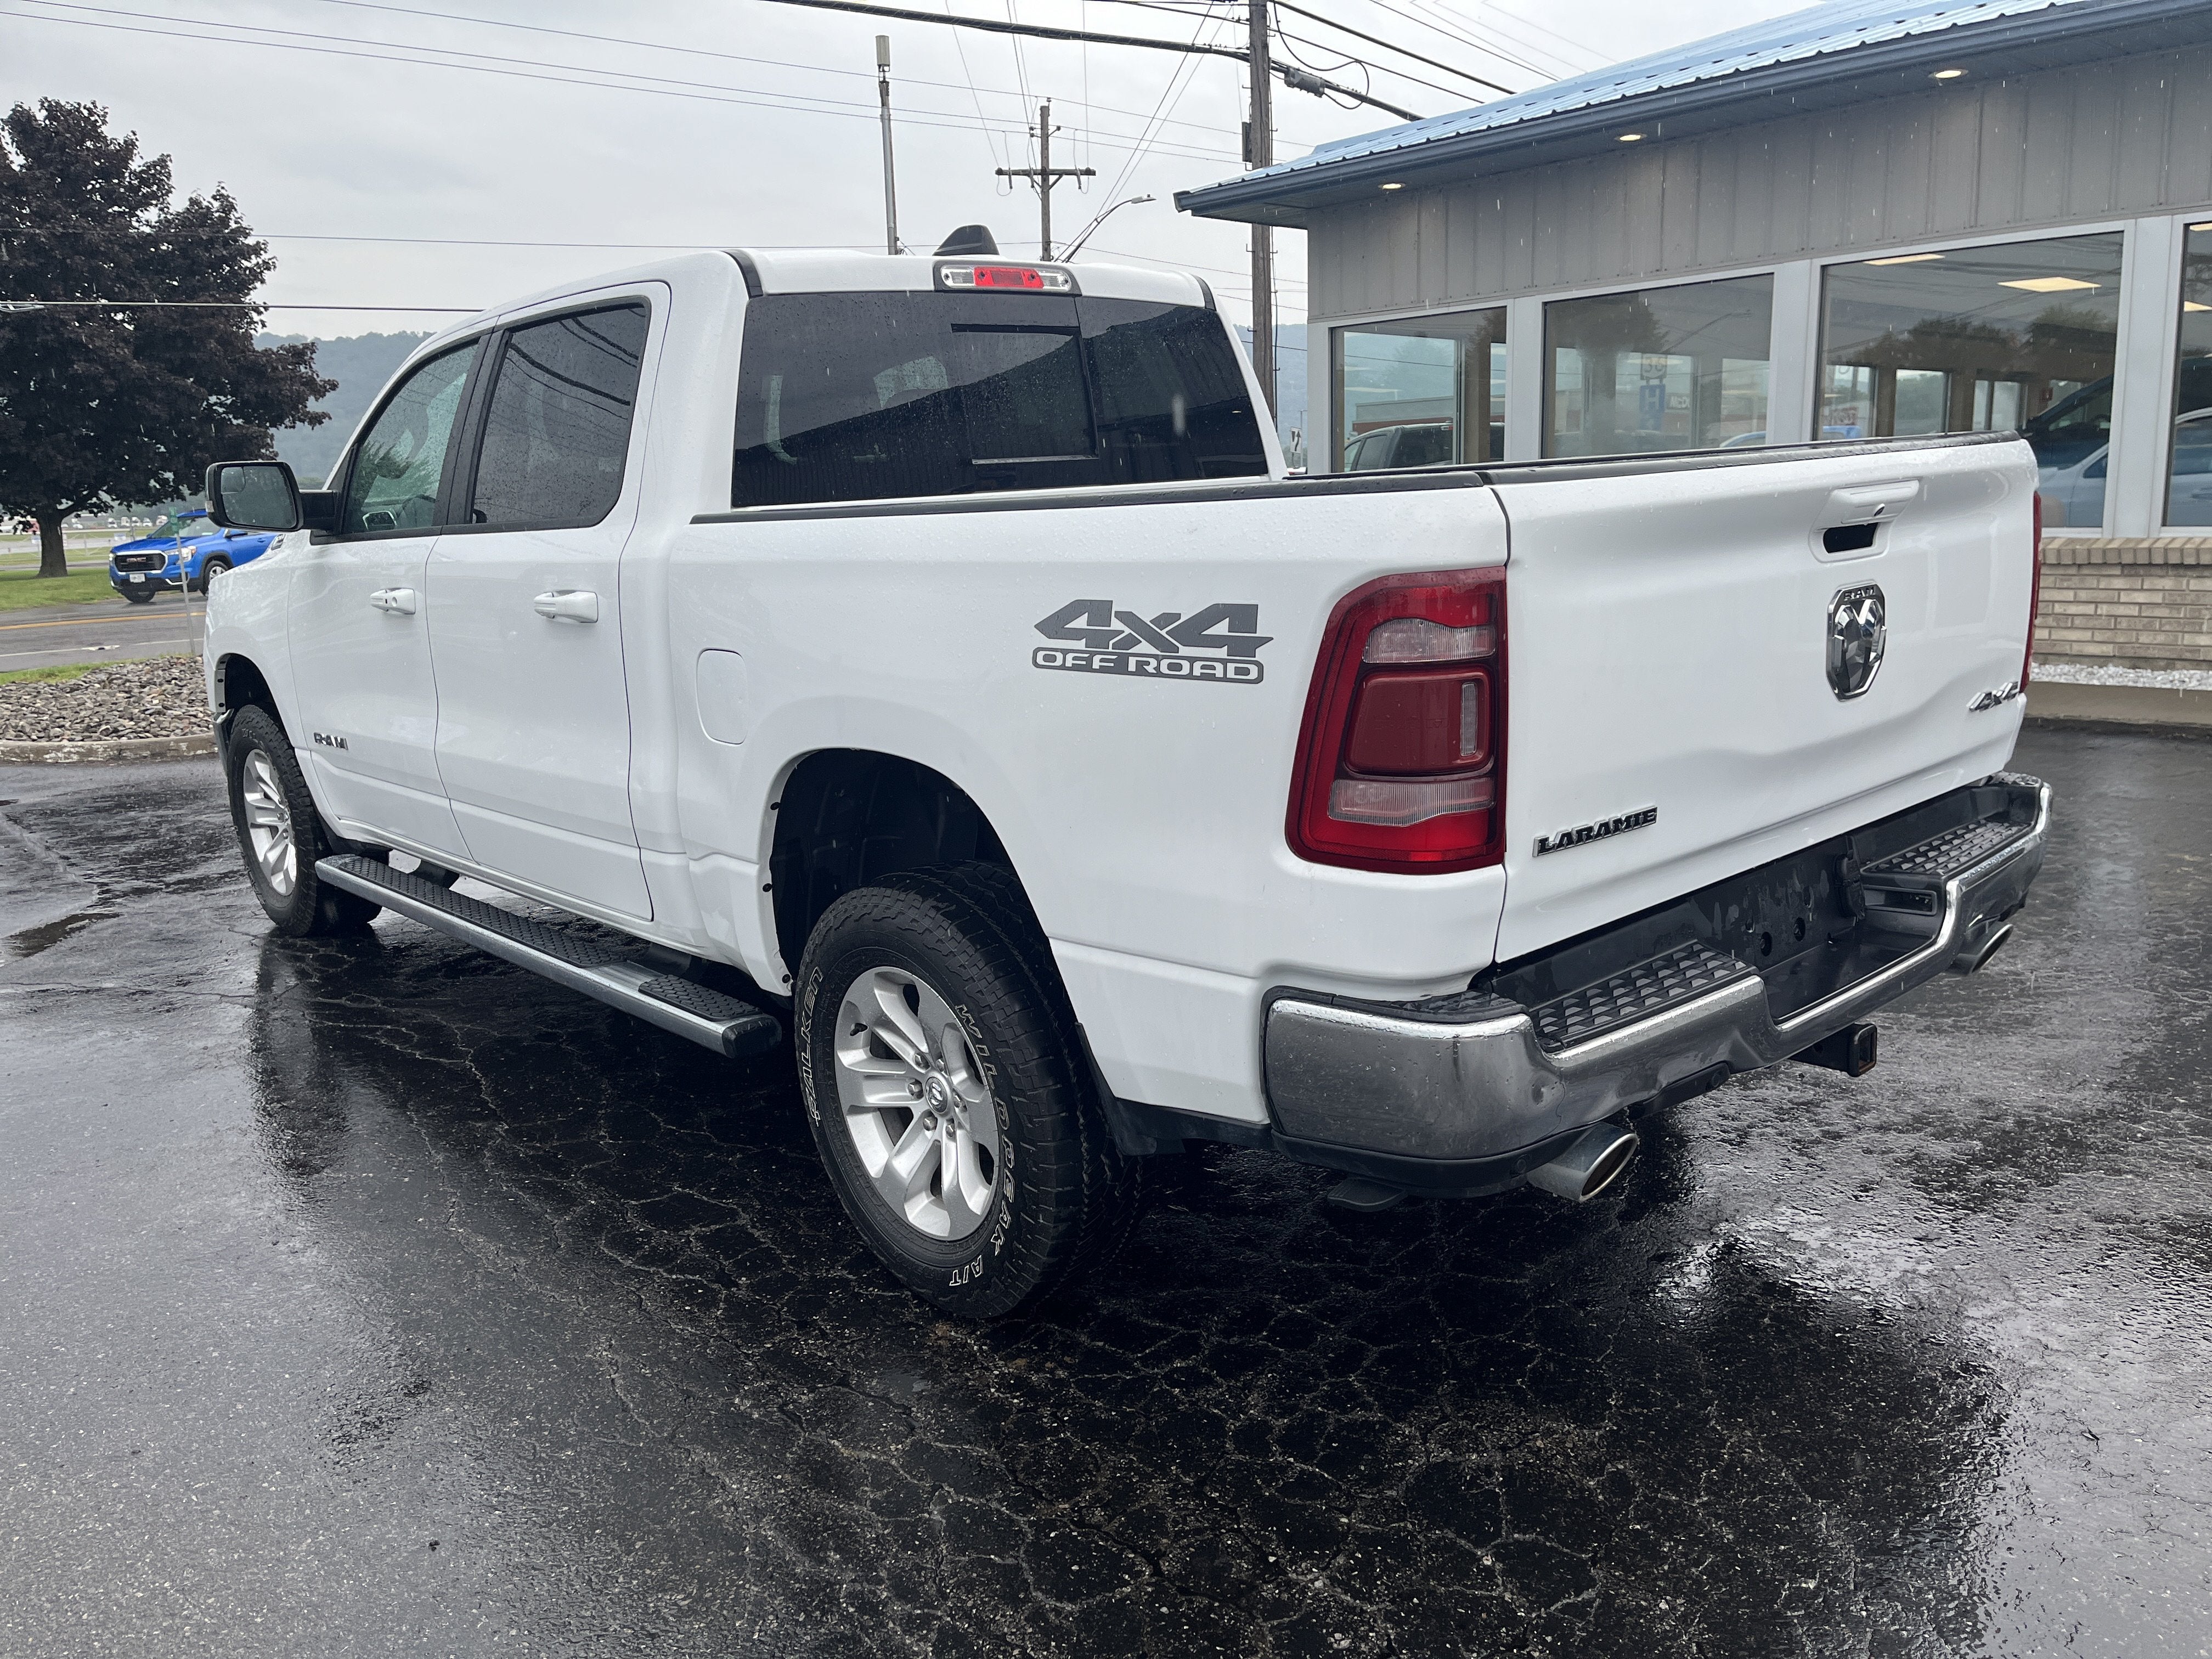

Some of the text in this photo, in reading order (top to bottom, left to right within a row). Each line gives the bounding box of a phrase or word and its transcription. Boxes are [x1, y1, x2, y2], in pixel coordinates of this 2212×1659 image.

[1844, 586, 1876, 601] RAM
[1035, 650, 1259, 680] OFF ROAD
[313, 732, 348, 751] RAM
[1533, 806, 1657, 857] LARAMIE
[801, 966, 823, 1127] FALKEN
[955, 1004, 1015, 1256] WILDPEAK
